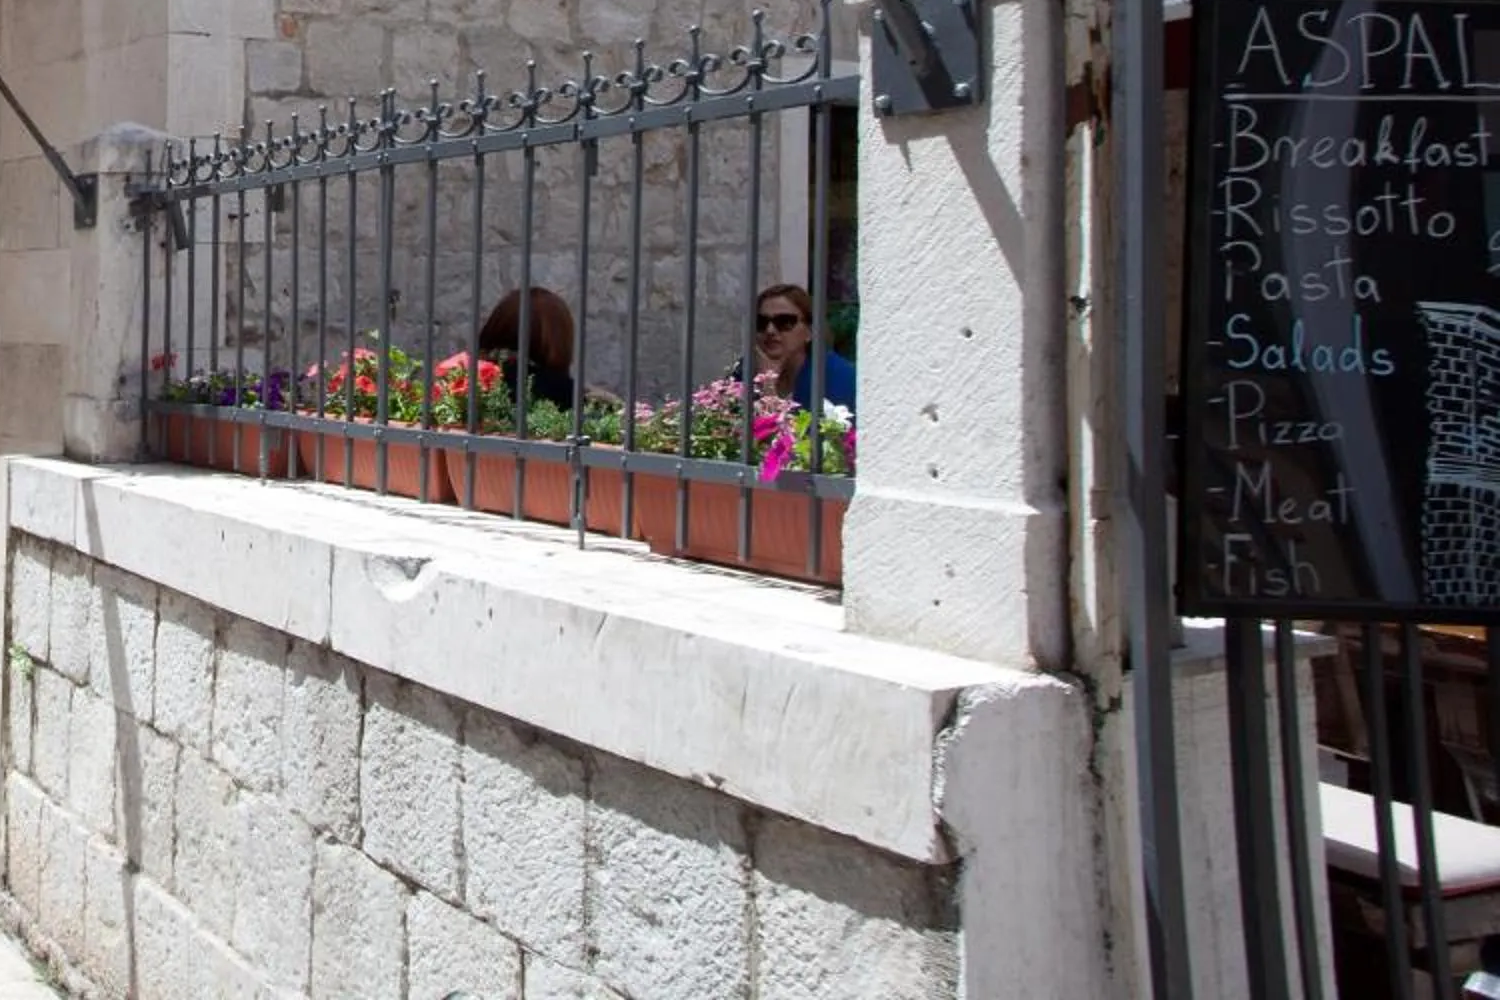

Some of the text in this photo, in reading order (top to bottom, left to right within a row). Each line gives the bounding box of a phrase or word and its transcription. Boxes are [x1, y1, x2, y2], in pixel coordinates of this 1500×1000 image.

[1235, 5, 1500, 89] ASPAL
[1227, 103, 1492, 173] Breakfast
[1218, 176, 1456, 238] Rissotto
[1219, 241, 1381, 302] Pasta
[1226, 313, 1395, 376] Salads
[1222, 379, 1344, 450] Pizza
[1227, 459, 1356, 525] Meat
[1223, 533, 1321, 597] Fish
